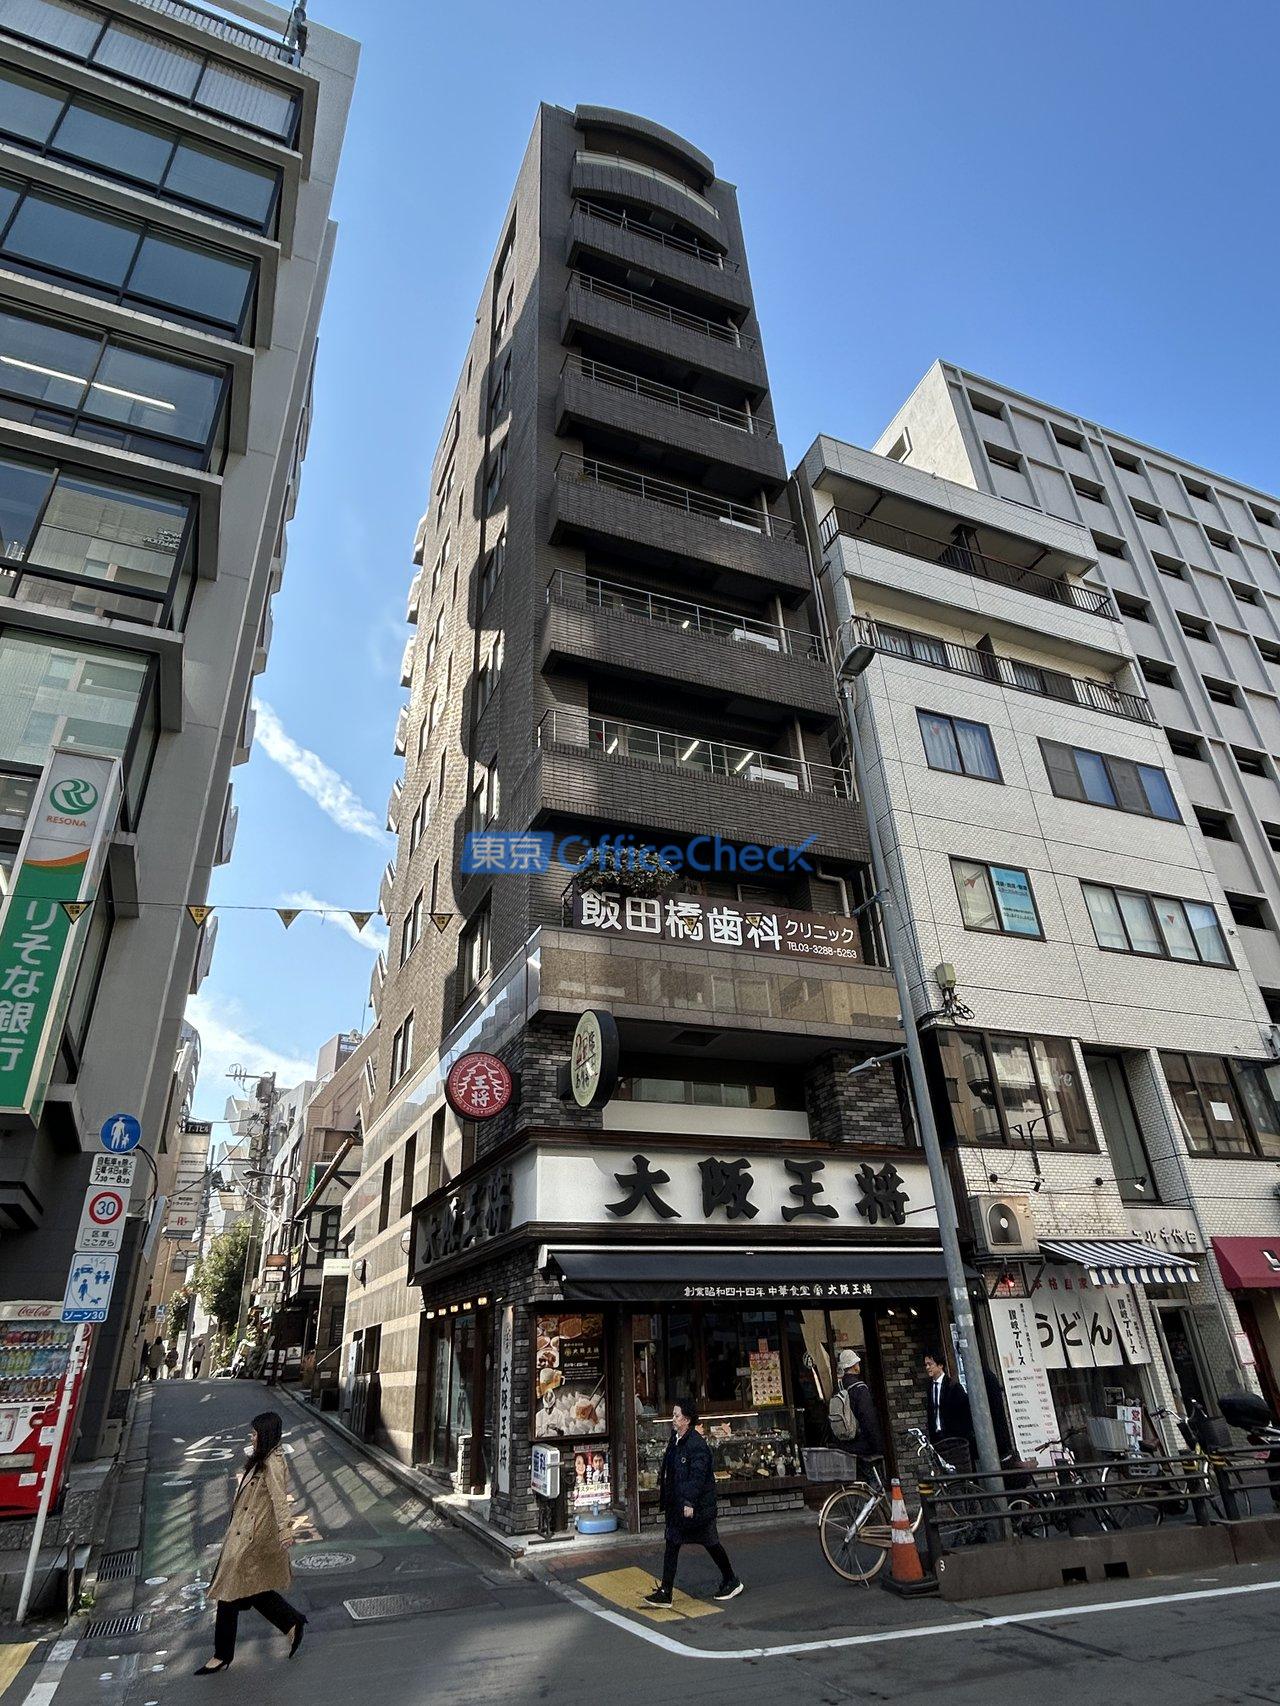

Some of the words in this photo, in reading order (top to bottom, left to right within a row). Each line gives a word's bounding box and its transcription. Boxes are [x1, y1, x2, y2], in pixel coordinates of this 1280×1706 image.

[47, 815, 87, 828] RESONA
[581, 888, 783, 951] 飯田橋歯科
[785, 920, 854, 944] クリニック
[787, 941, 857, 959] TEL03-3288-5253
[0, 900, 58, 1072] りそな銀行
[471, 1075, 490, 1107] 王将
[604, 1154, 911, 1225] 大阪王将
[95, 1200, 117, 1216] 30
[82, 1238, 115, 1248] ここから
[91, 1229, 111, 1239] 区域
[827, 1283, 873, 1296] 大阪王将
[1034, 1311, 1113, 1349] うどん
